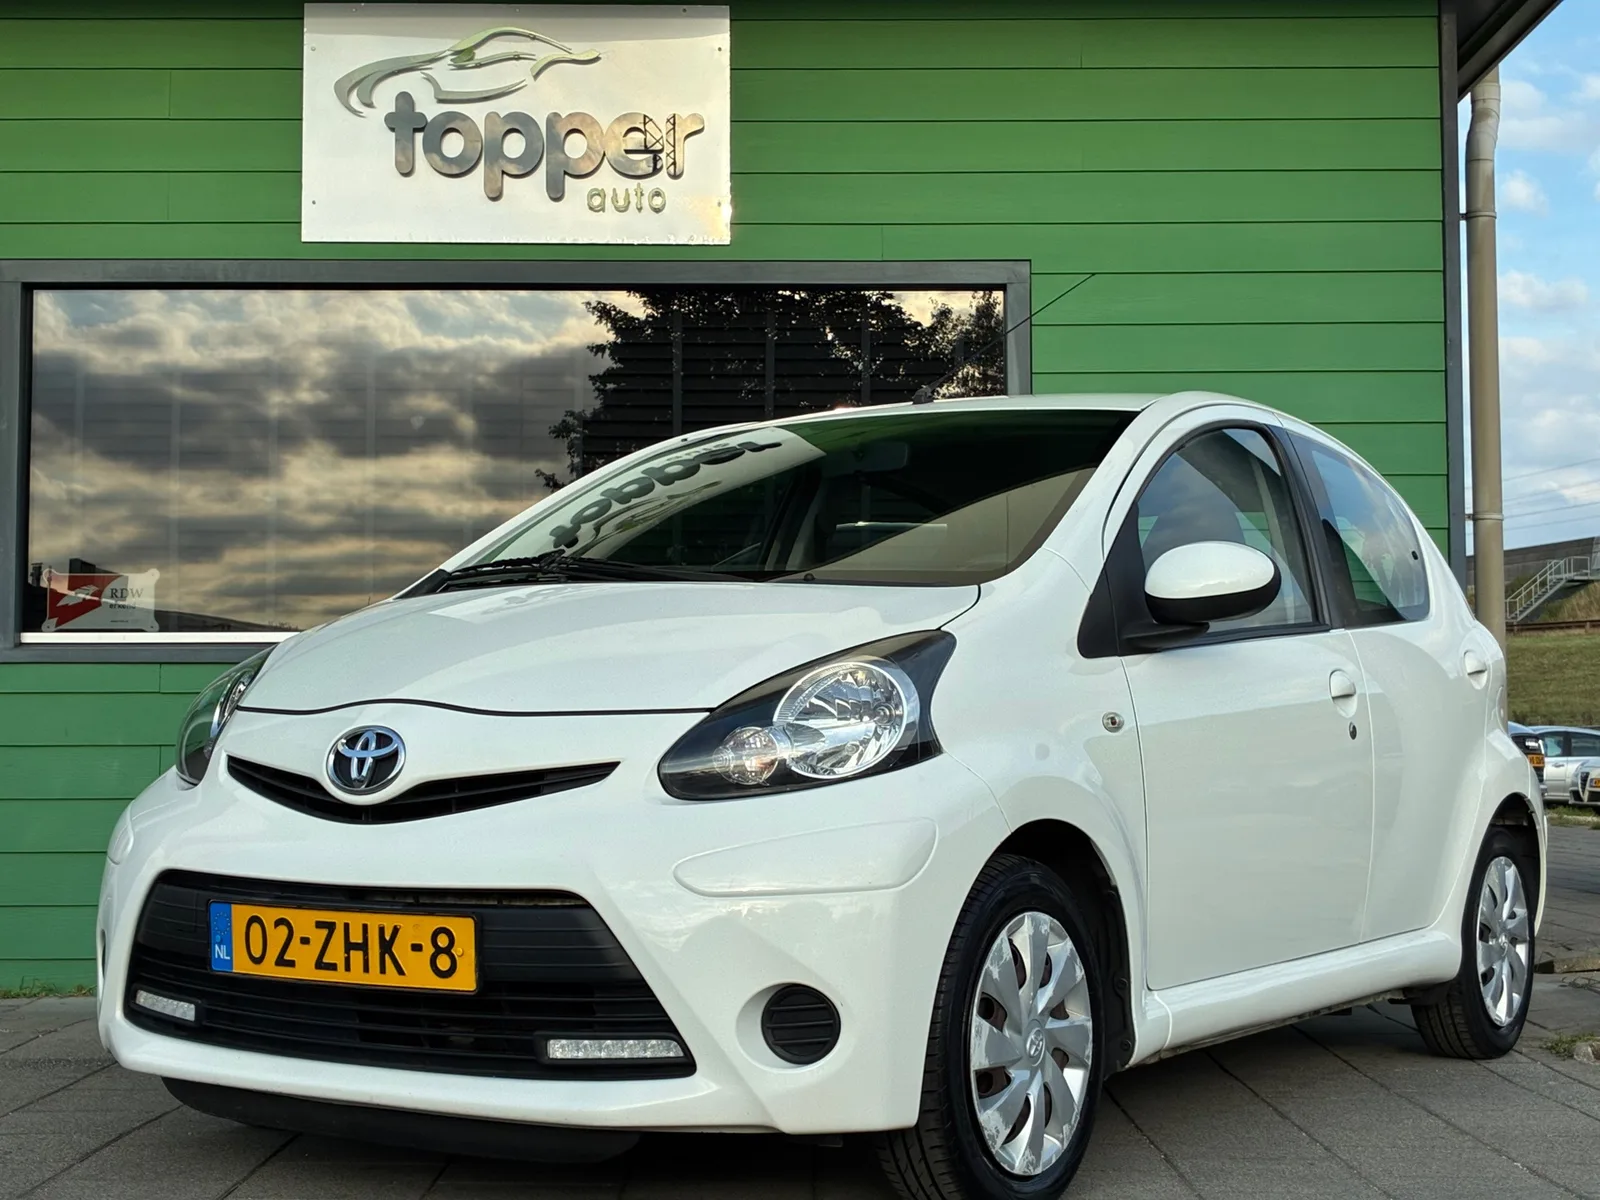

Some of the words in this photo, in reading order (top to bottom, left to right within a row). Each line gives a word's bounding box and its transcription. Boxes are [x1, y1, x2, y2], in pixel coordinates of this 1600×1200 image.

[384, 91, 704, 200] topper
[587, 182, 666, 213] auto
[110, 587, 144, 599] RDW
[215, 944, 230, 960] NL
[244, 914, 457, 979] 02-ZHK-8
